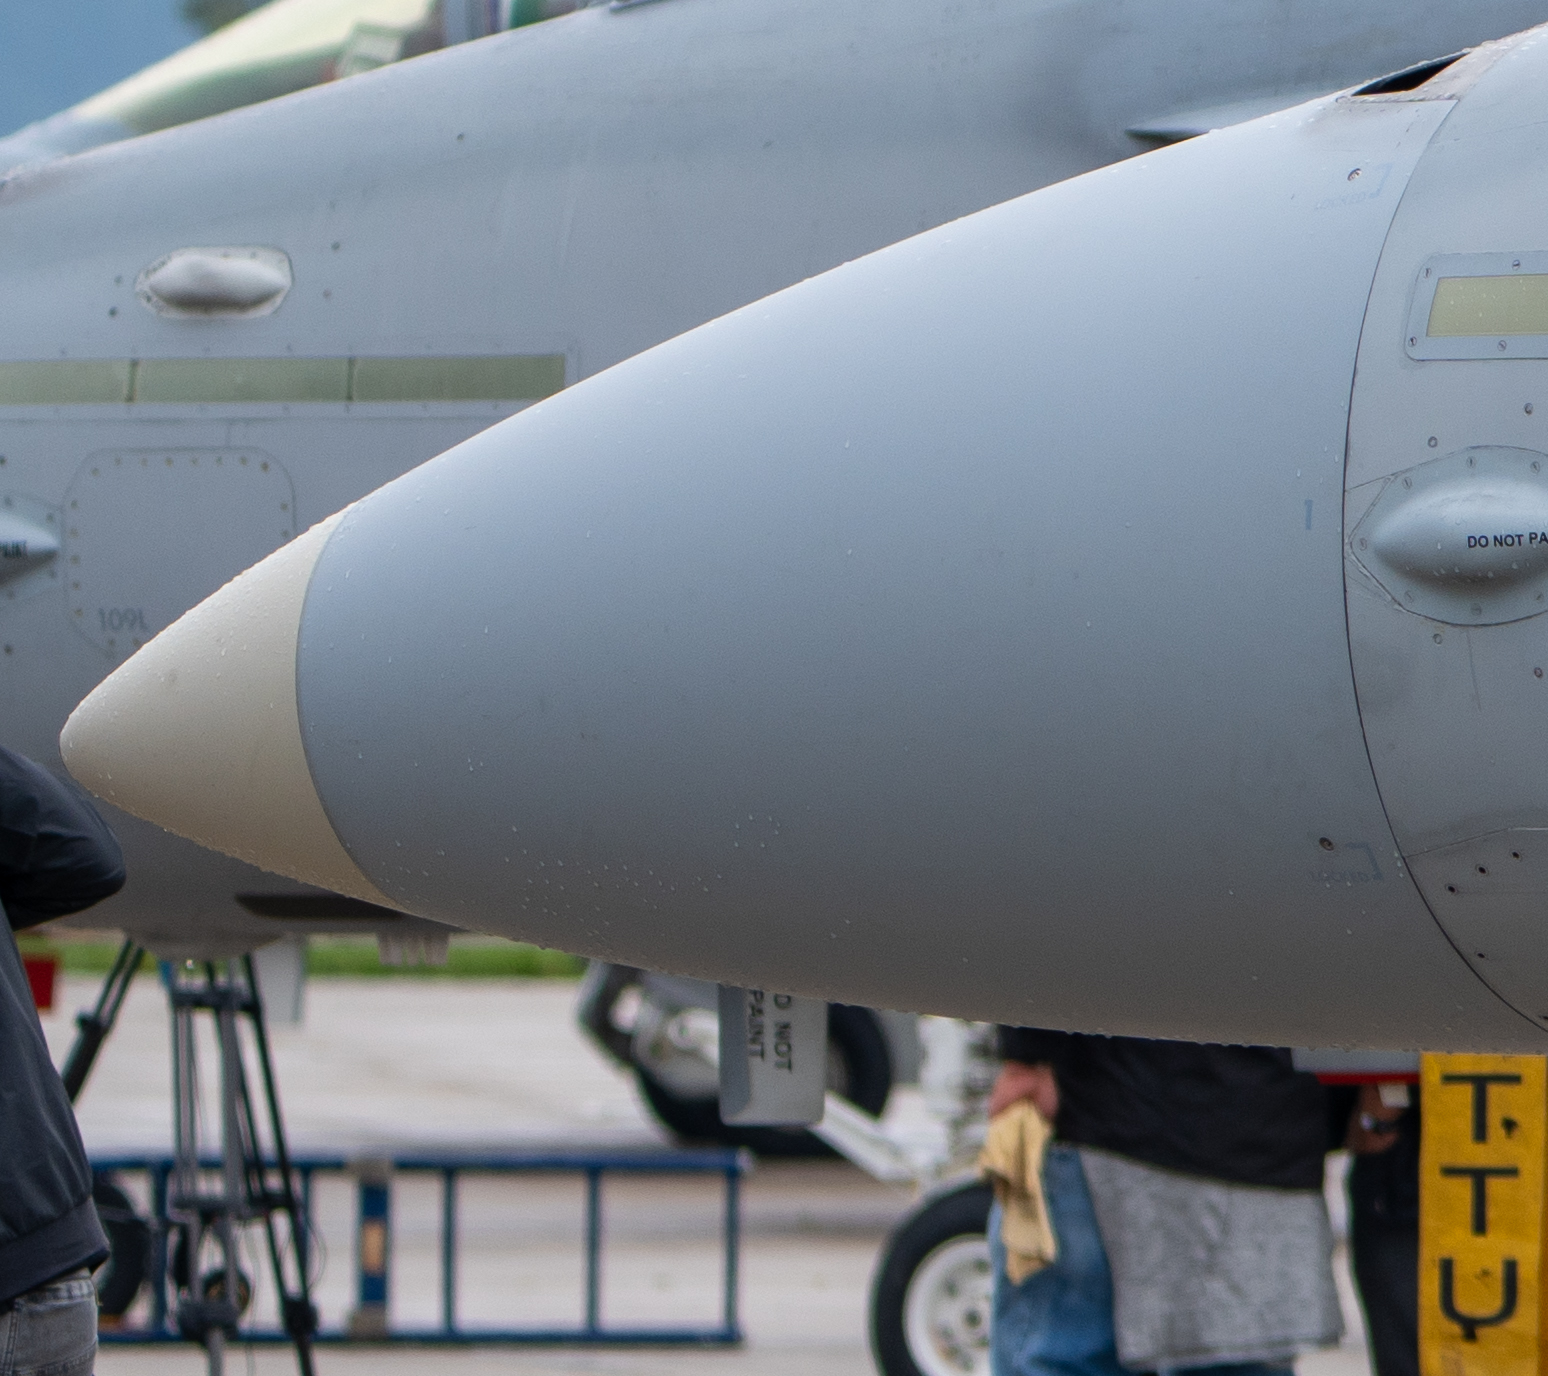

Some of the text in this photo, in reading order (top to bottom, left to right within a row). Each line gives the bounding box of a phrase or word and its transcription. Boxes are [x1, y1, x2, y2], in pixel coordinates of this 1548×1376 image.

[1467, 535, 1489, 548] DO
[1493, 533, 1524, 547] NOT
[98, 607, 149, 633] 109L
